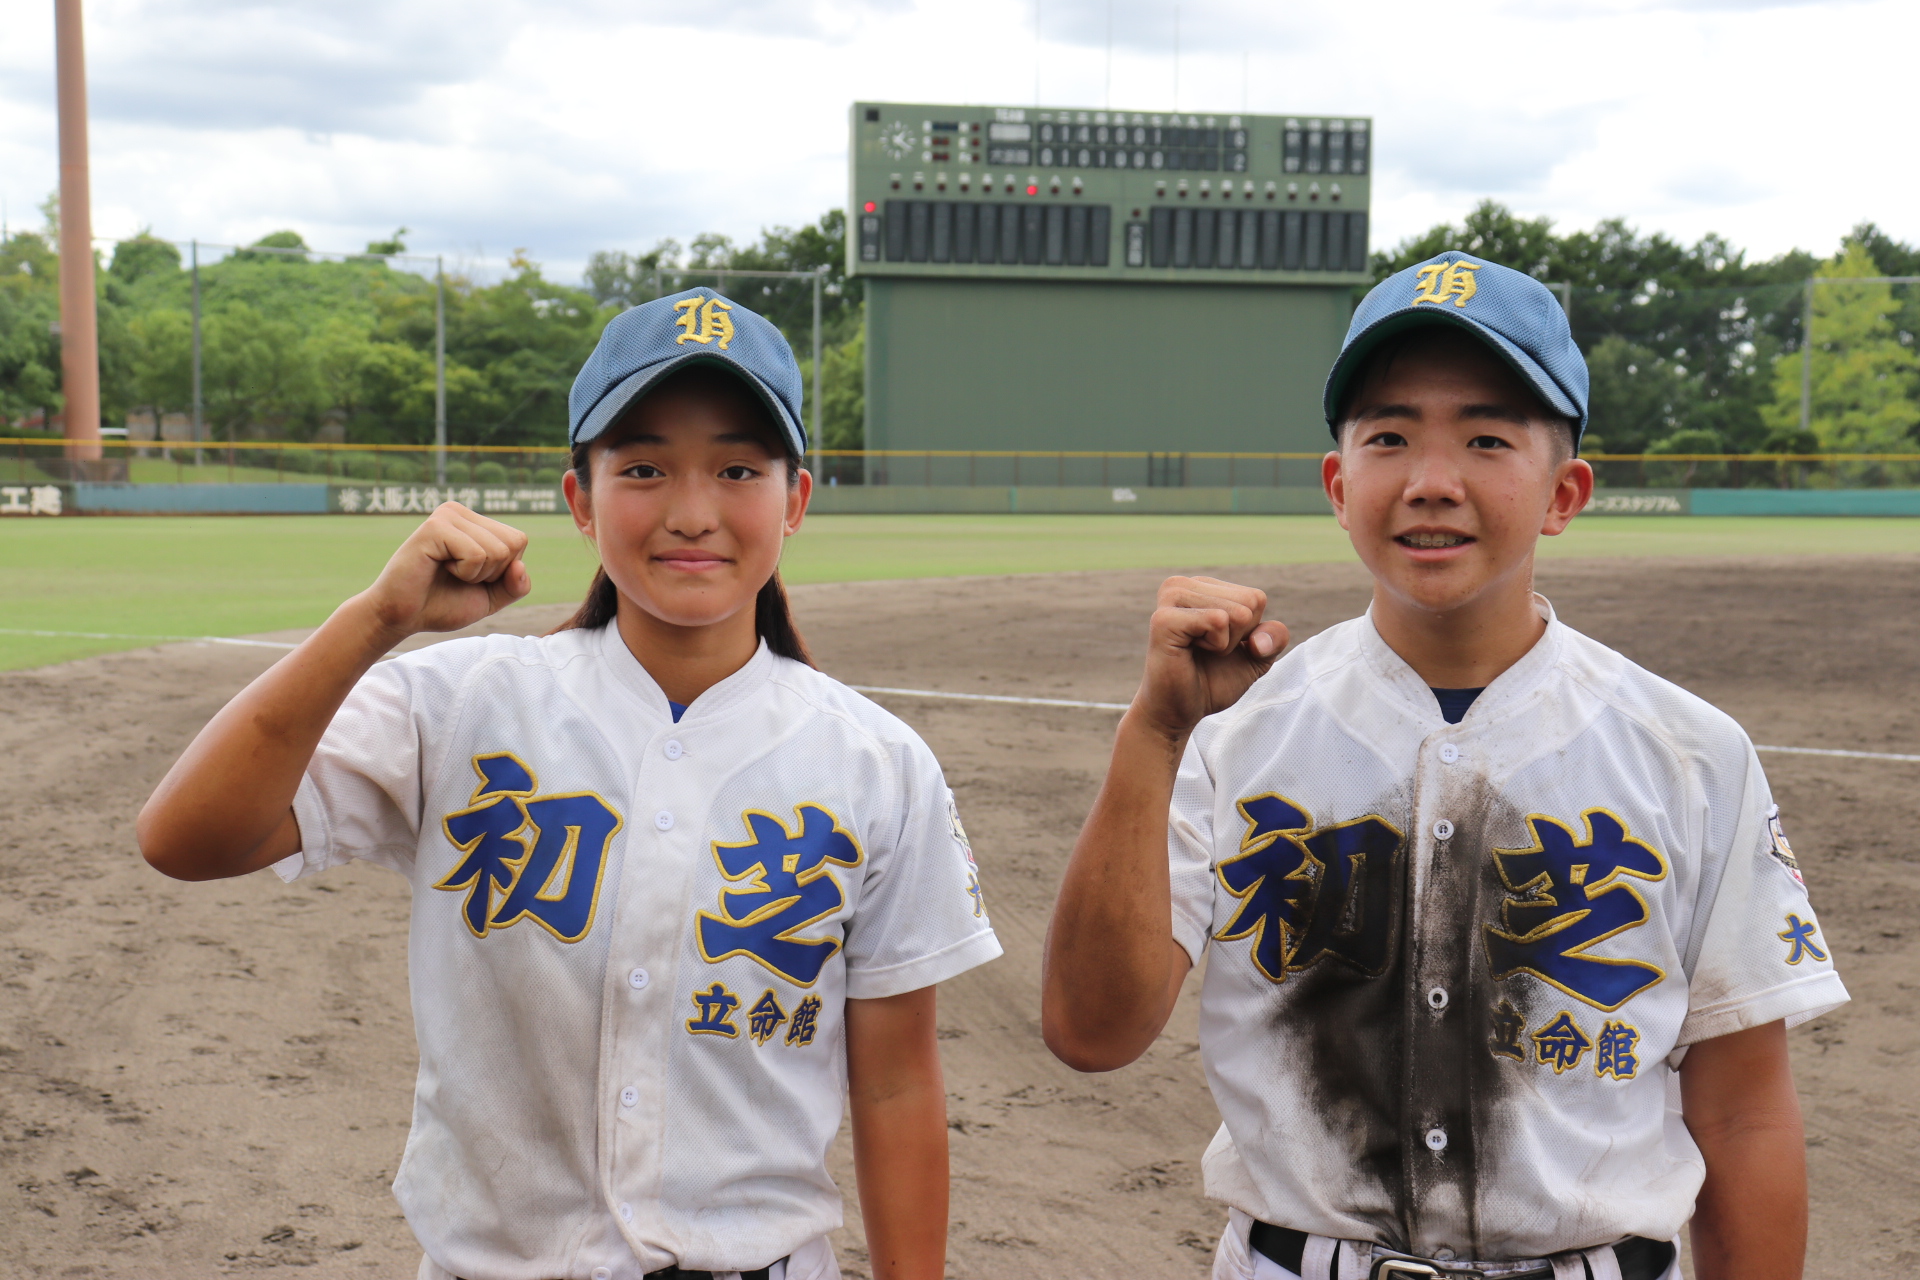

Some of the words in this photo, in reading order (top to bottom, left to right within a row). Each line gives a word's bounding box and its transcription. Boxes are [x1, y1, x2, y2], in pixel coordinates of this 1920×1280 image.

[995, 109, 1025, 122] TEAM
[1234, 153, 1245, 172] 2
[1411, 260, 1482, 308] H
[673, 295, 735, 350] H
[1777, 913, 1827, 965] 大
[685, 981, 822, 1048] 立命館
[1489, 1000, 1640, 1081] 立命館
